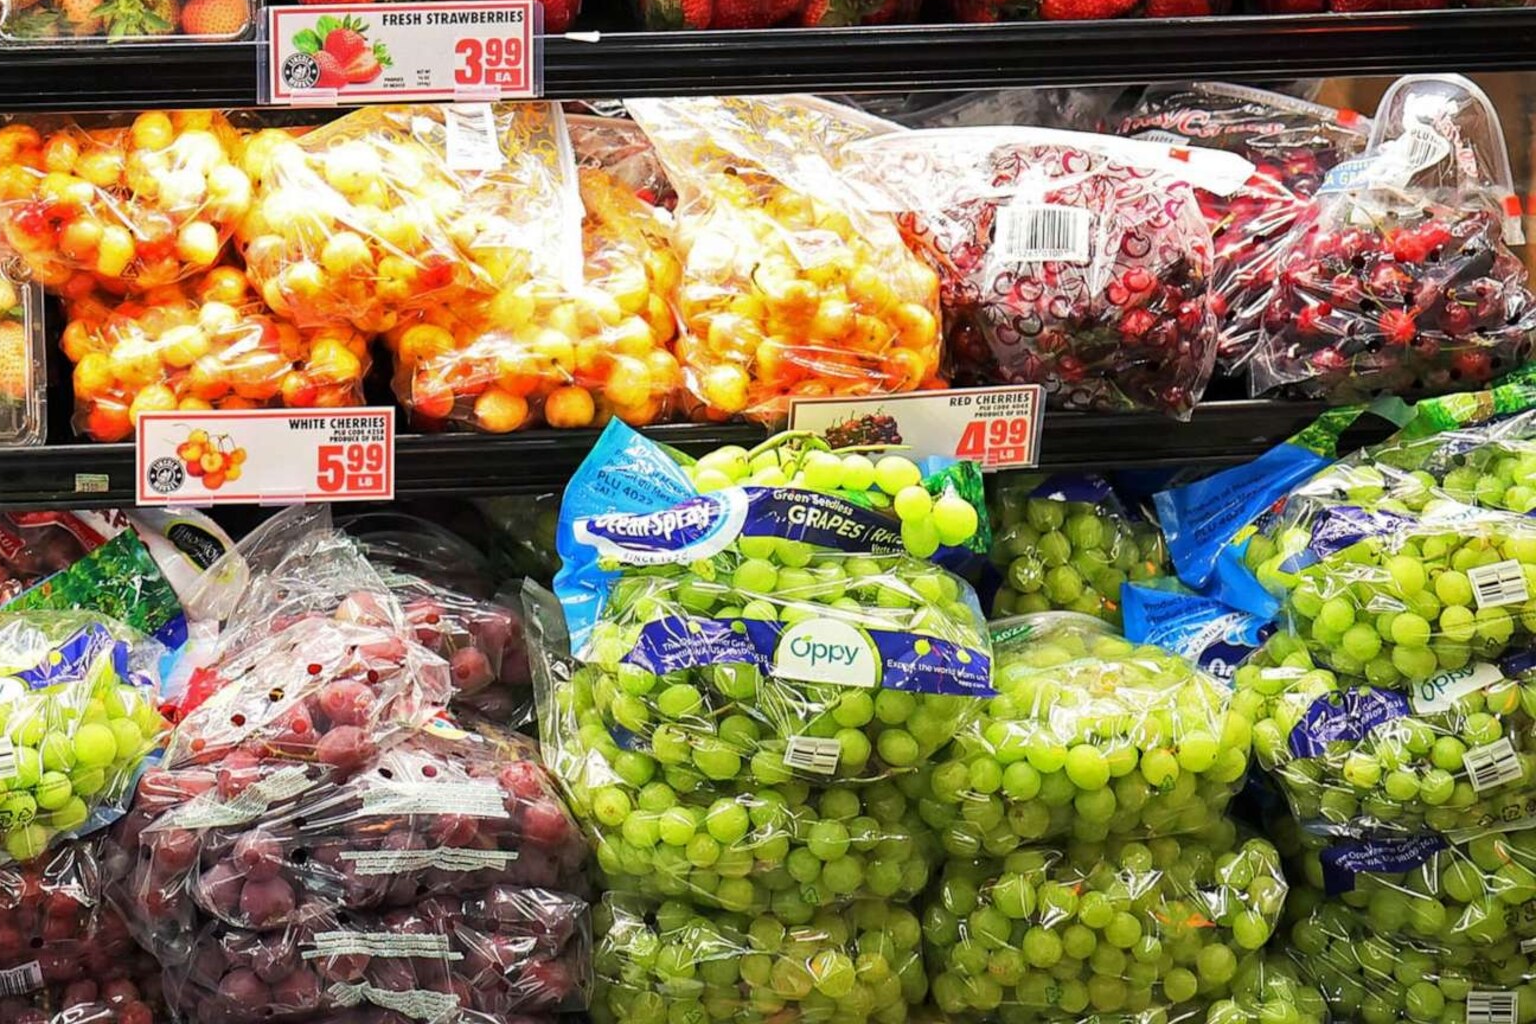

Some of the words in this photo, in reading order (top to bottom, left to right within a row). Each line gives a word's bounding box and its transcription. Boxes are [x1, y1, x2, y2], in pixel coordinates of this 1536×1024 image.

[382, 13, 422, 26] FRESH
[426, 10, 524, 25] STRAWBERRIES
[494, 71, 512, 83] EA
[949, 396, 972, 407] RED
[975, 392, 1030, 405] CHERRIES
[289, 418, 326, 430] WHITE
[329, 417, 385, 428] CHERRIES
[596, 470, 622, 490] PLU
[772, 489, 809, 504] Green
[808, 493, 854, 515] Seedless
[787, 504, 865, 539] GRAPES
[790, 636, 859, 666] Oppy
[918, 663, 933, 673] the
